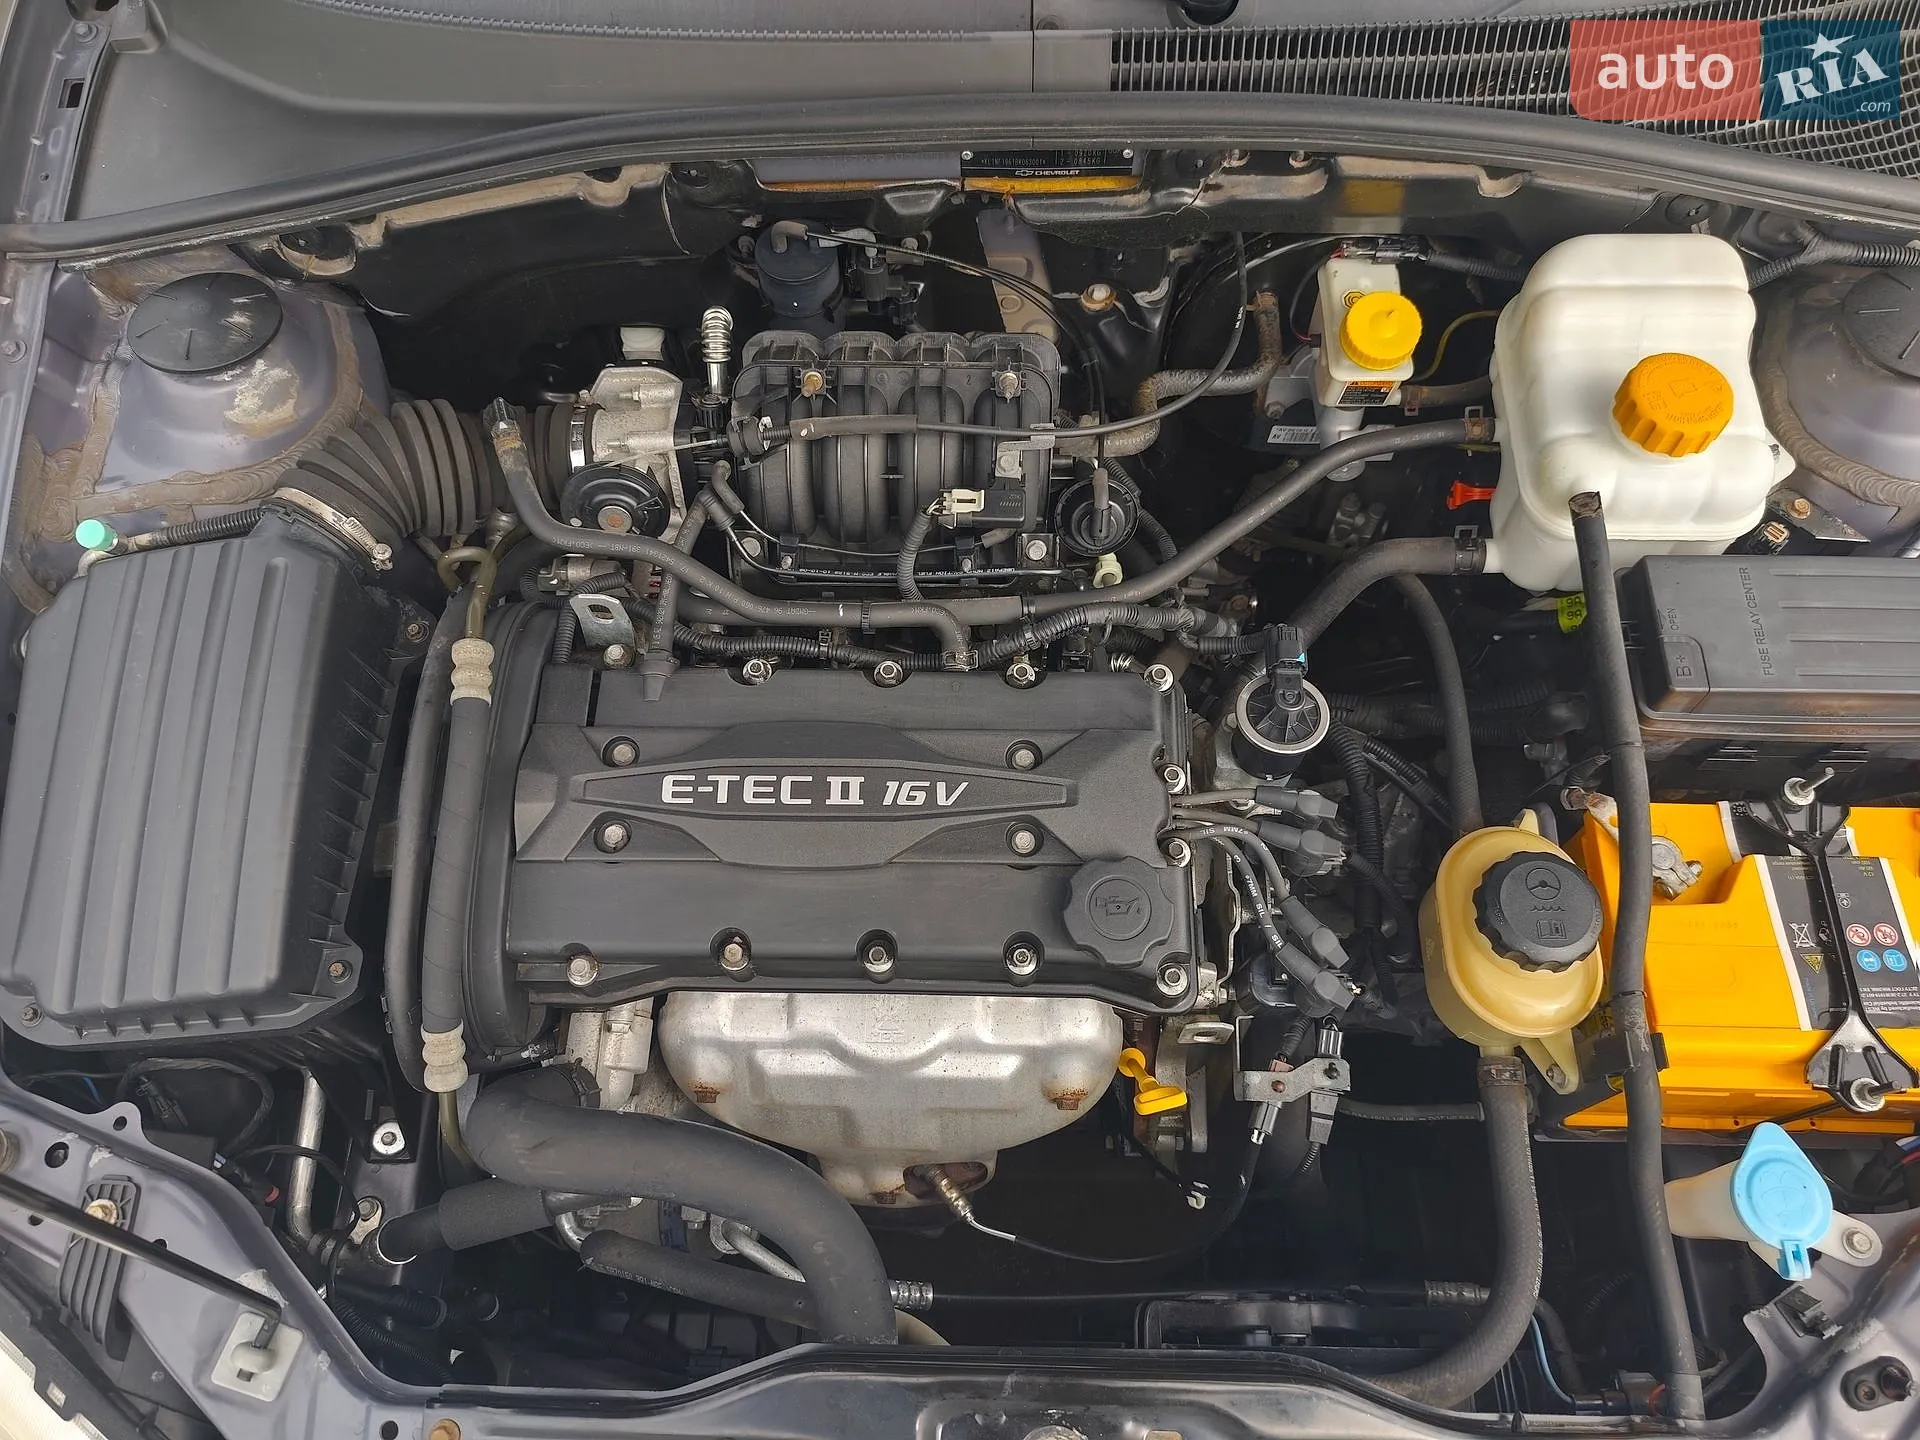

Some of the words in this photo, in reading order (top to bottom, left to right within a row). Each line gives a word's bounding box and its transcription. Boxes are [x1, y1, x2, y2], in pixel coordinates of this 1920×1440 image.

[1035, 169, 1080, 177] CHEVROLET
[1739, 567, 1757, 609] CENTER
[1667, 607, 1679, 631] OPEN
[1750, 610, 1768, 645] RELAY
[1759, 646, 1775, 676] FUSE
[661, 775, 813, 805] E-TEC
[825, 775, 865, 805] II
[1255, 903, 1267, 919] SIL
[1271, 934, 1286, 949] SIL
